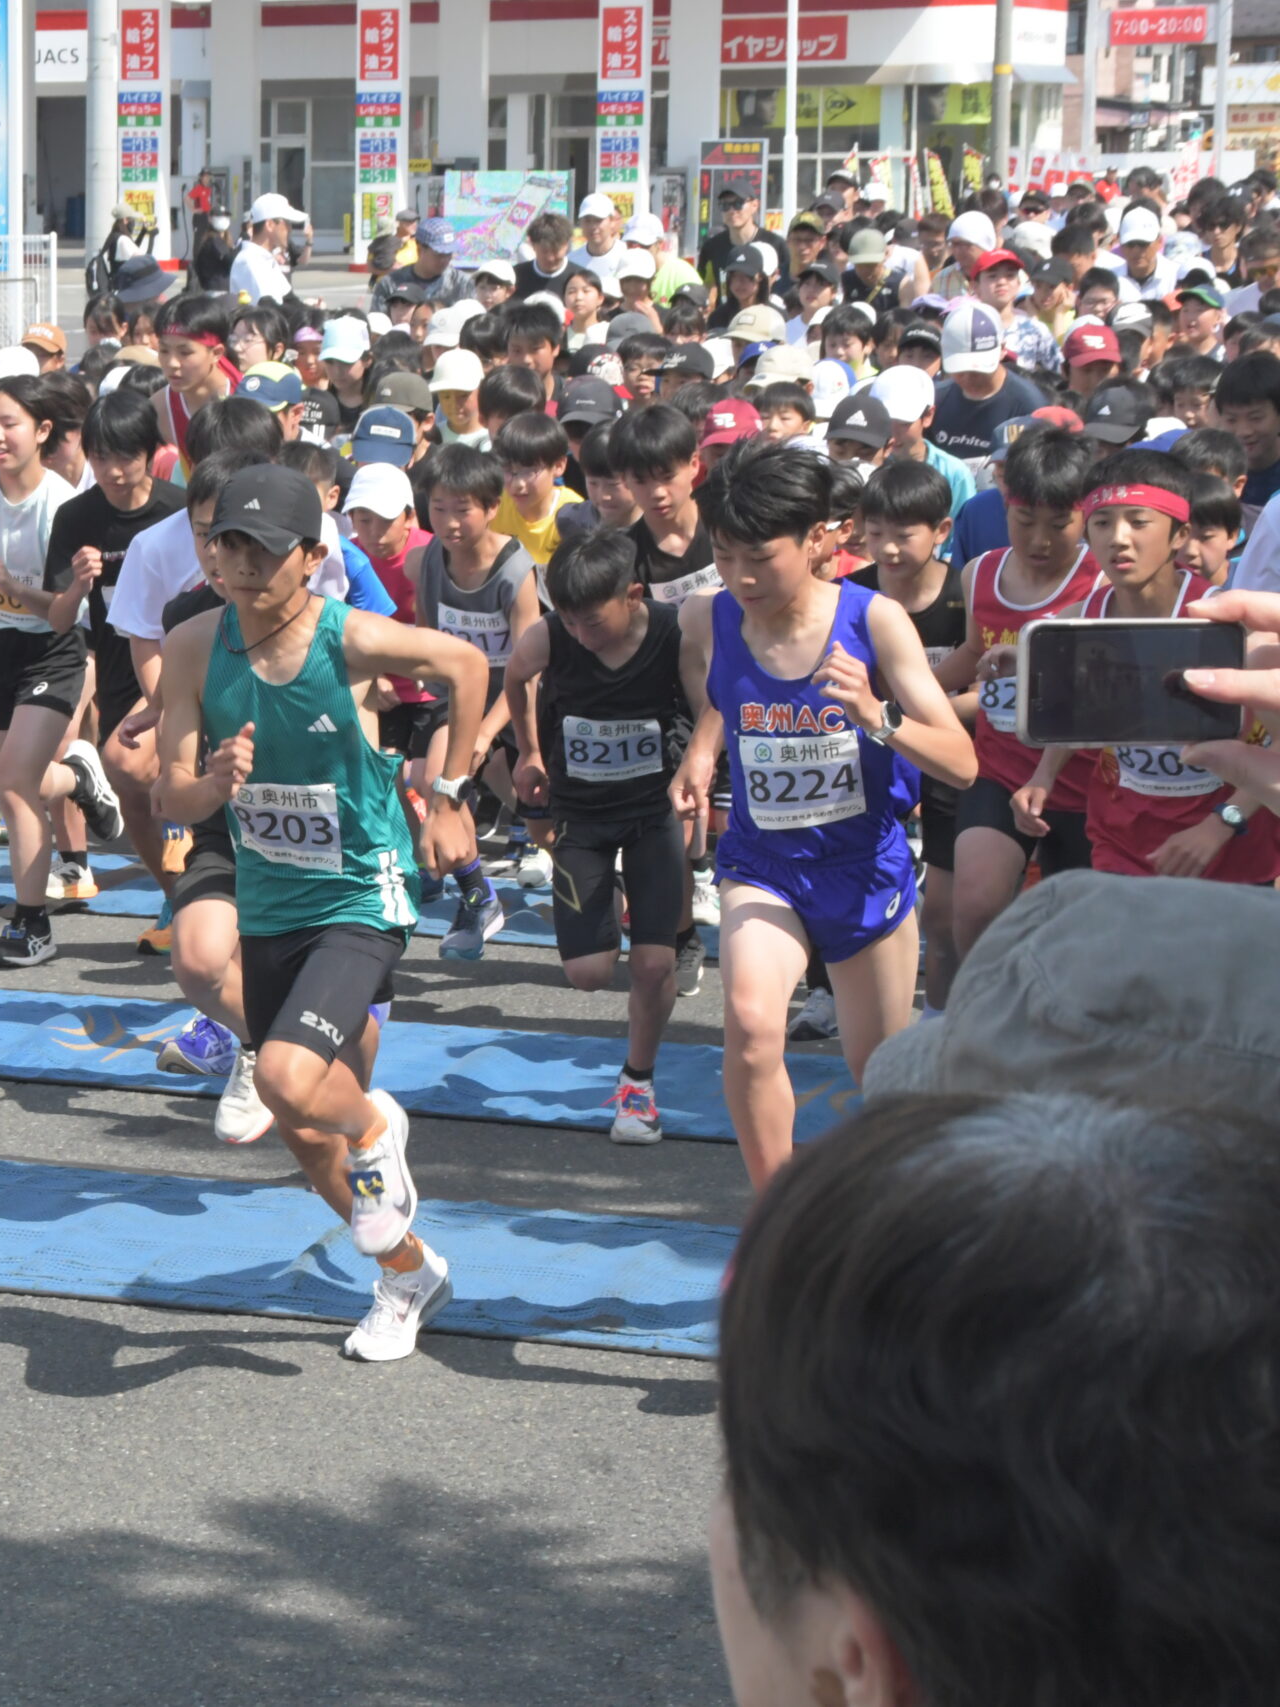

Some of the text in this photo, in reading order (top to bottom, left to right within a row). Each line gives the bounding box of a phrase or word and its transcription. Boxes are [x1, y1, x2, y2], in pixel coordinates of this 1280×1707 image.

[141, 12, 155, 70] スタッフ
[380, 12, 394, 70] スタッフ
[624, 9, 638, 69] スタッフ
[35, 48, 80, 65] JACS
[121, 105, 158, 114] レギュラー
[122, 93, 158, 103] ハイオク
[361, 93, 397, 103] ハイオク
[601, 104, 639, 114] レギュラー
[603, 91, 640, 102] ハイオク
[359, 105, 397, 115] レギュラー
[740, 702, 845, 734] 奥州AC
[569, 735, 658, 765] 8216
[780, 741, 841, 763] 奥州市
[1117, 745, 1208, 776] 820
[748, 762, 859, 804] 8224
[261, 787, 320, 809] 奥州市
[234, 805, 334, 846] 8203
[300, 1010, 344, 1047] 2XU
